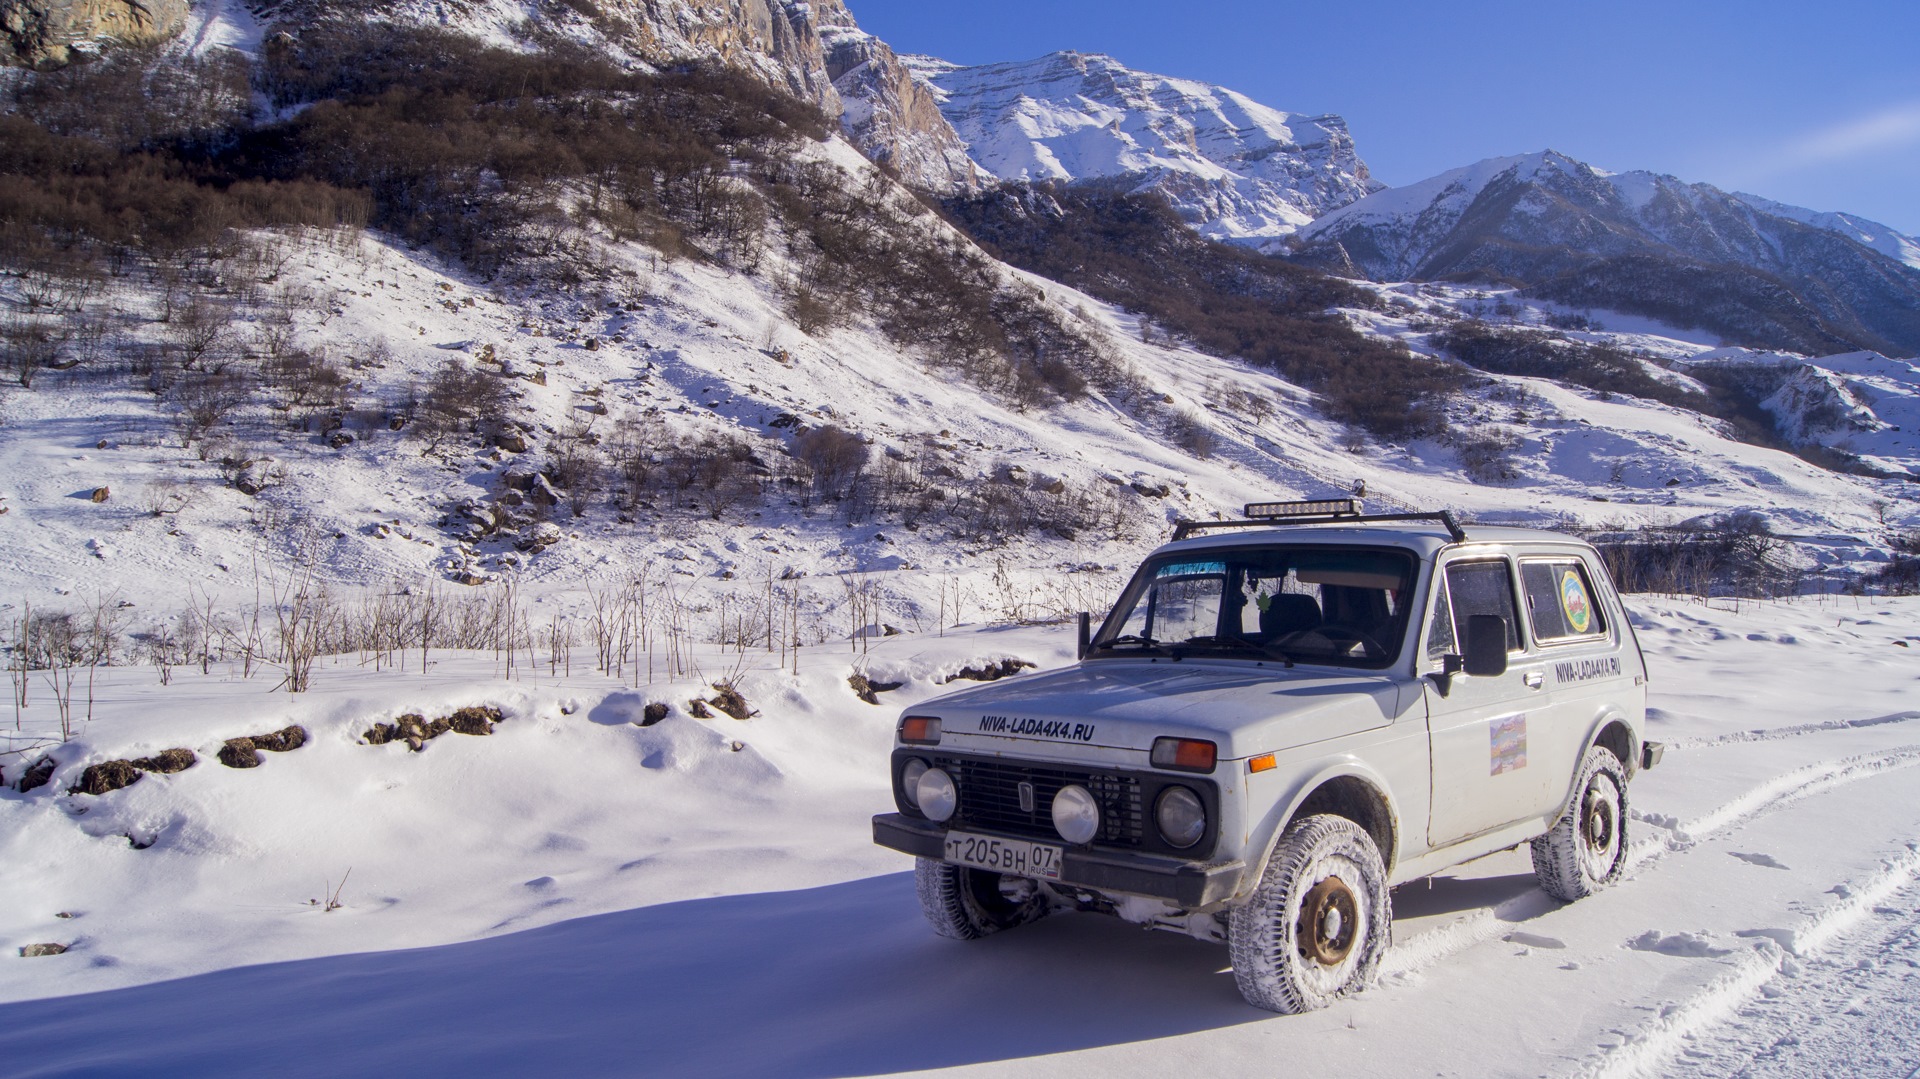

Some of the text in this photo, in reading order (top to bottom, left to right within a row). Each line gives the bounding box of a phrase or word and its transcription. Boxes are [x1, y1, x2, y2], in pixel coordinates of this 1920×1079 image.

[1555, 657, 1621, 684] NIVA-LADA4X4.RU
[979, 715, 1095, 741] NIVA-LADA4X4.RU
[1032, 846, 1054, 868] 07
[1030, 866, 1047, 876] RUS
